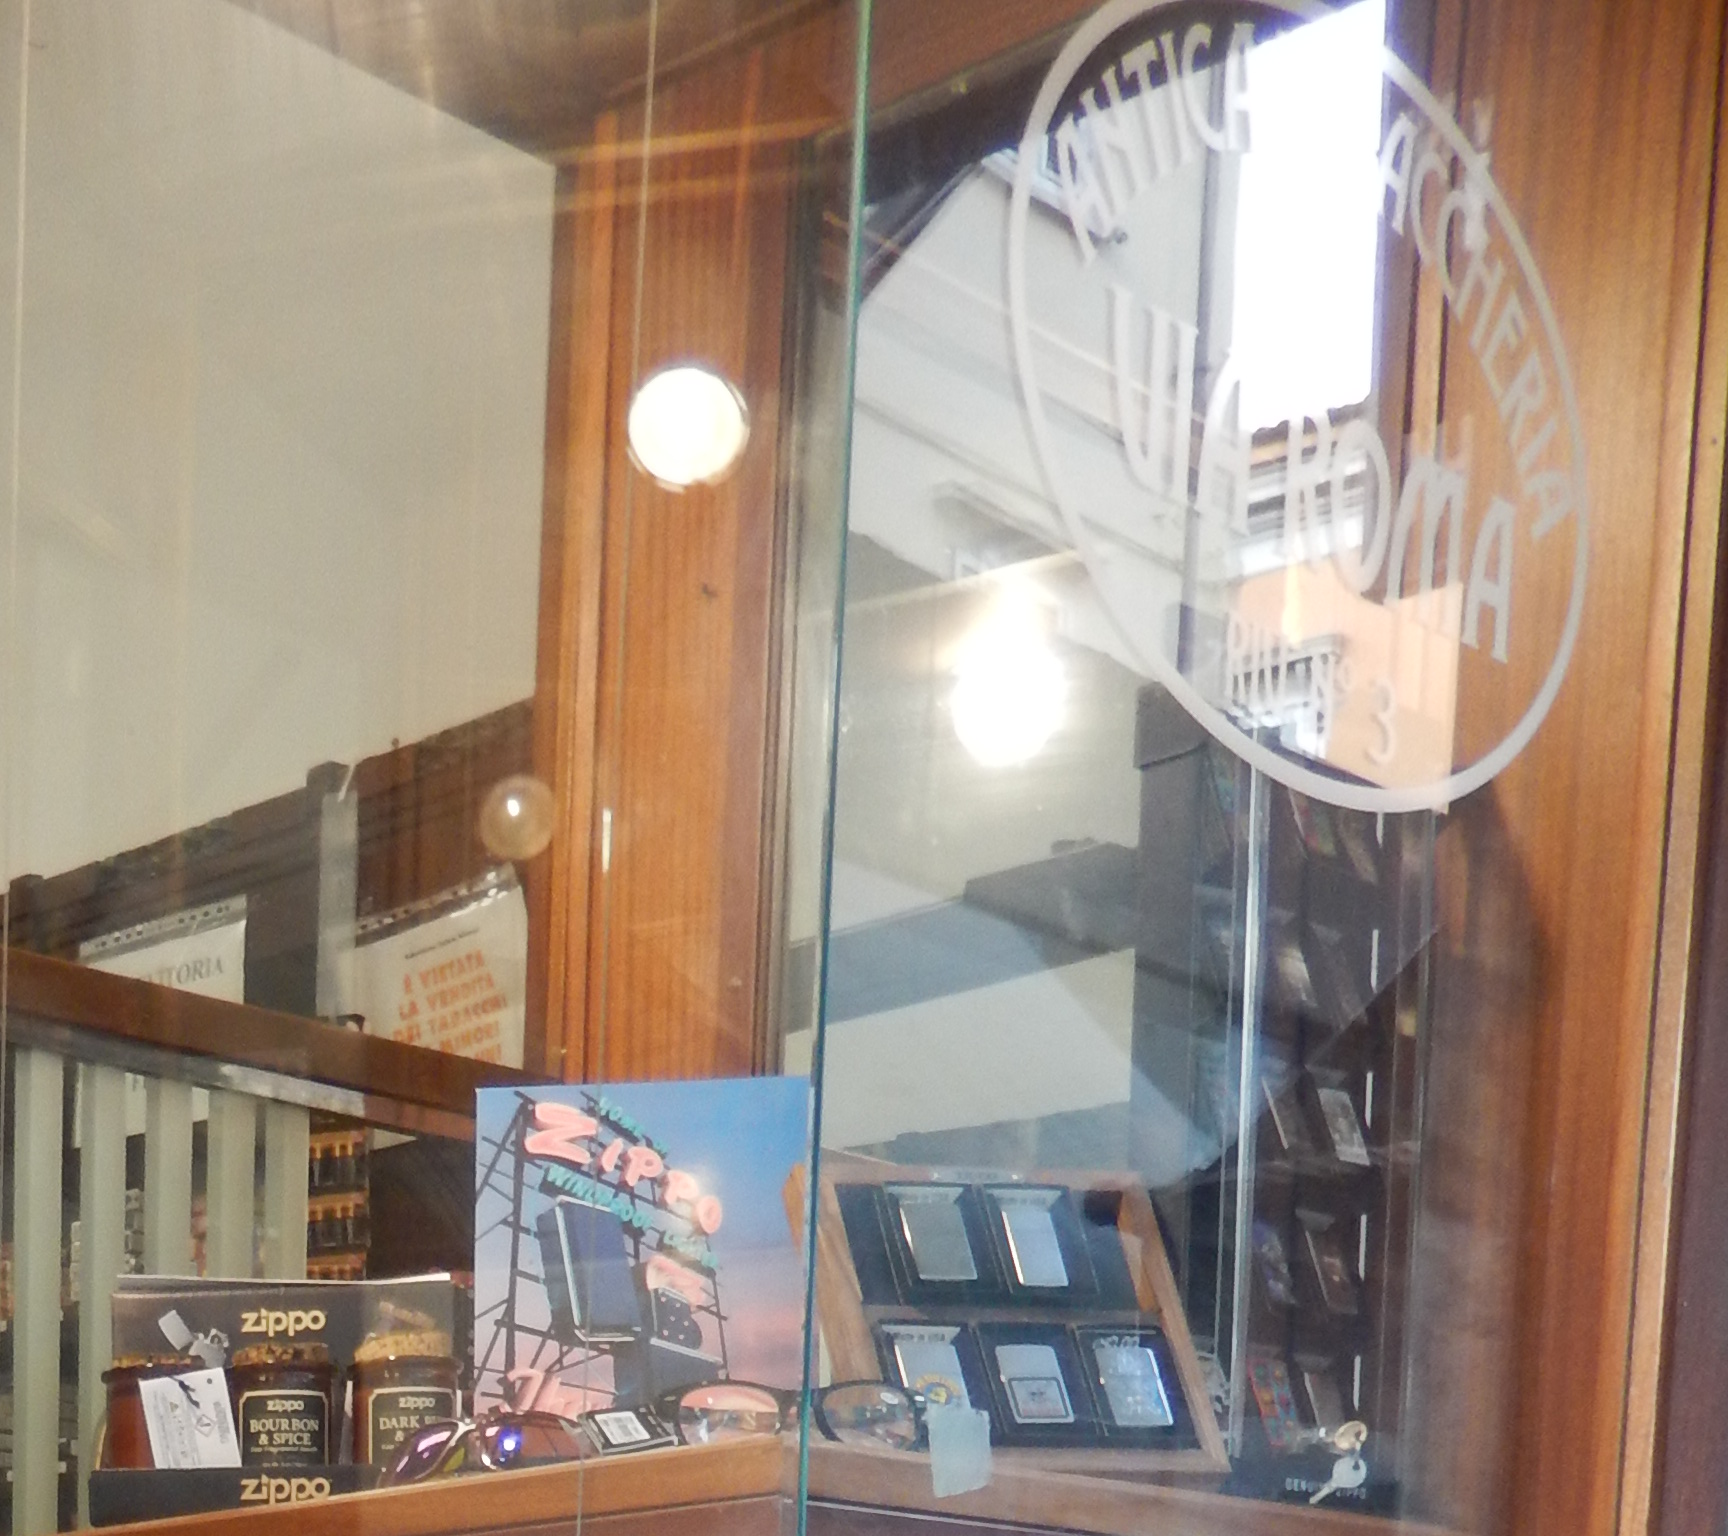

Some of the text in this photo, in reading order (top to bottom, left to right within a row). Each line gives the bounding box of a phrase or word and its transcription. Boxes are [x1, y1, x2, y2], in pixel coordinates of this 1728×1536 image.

[1057, 22, 1253, 267] ANTICA
[1104, 284, 1516, 663] VIA ROMA
[1366, 675, 1400, 766] 3
[525, 1102, 722, 1234] ZIPPO
[240, 1307, 326, 1337] zippo
[267, 1399, 305, 1413] zippo
[398, 1396, 435, 1410] zippo
[249, 1418, 319, 1432] BOURBON
[379, 1416, 420, 1430] DARK
[258, 1432, 312, 1446] & SPICE
[240, 1474, 330, 1503] zippo
